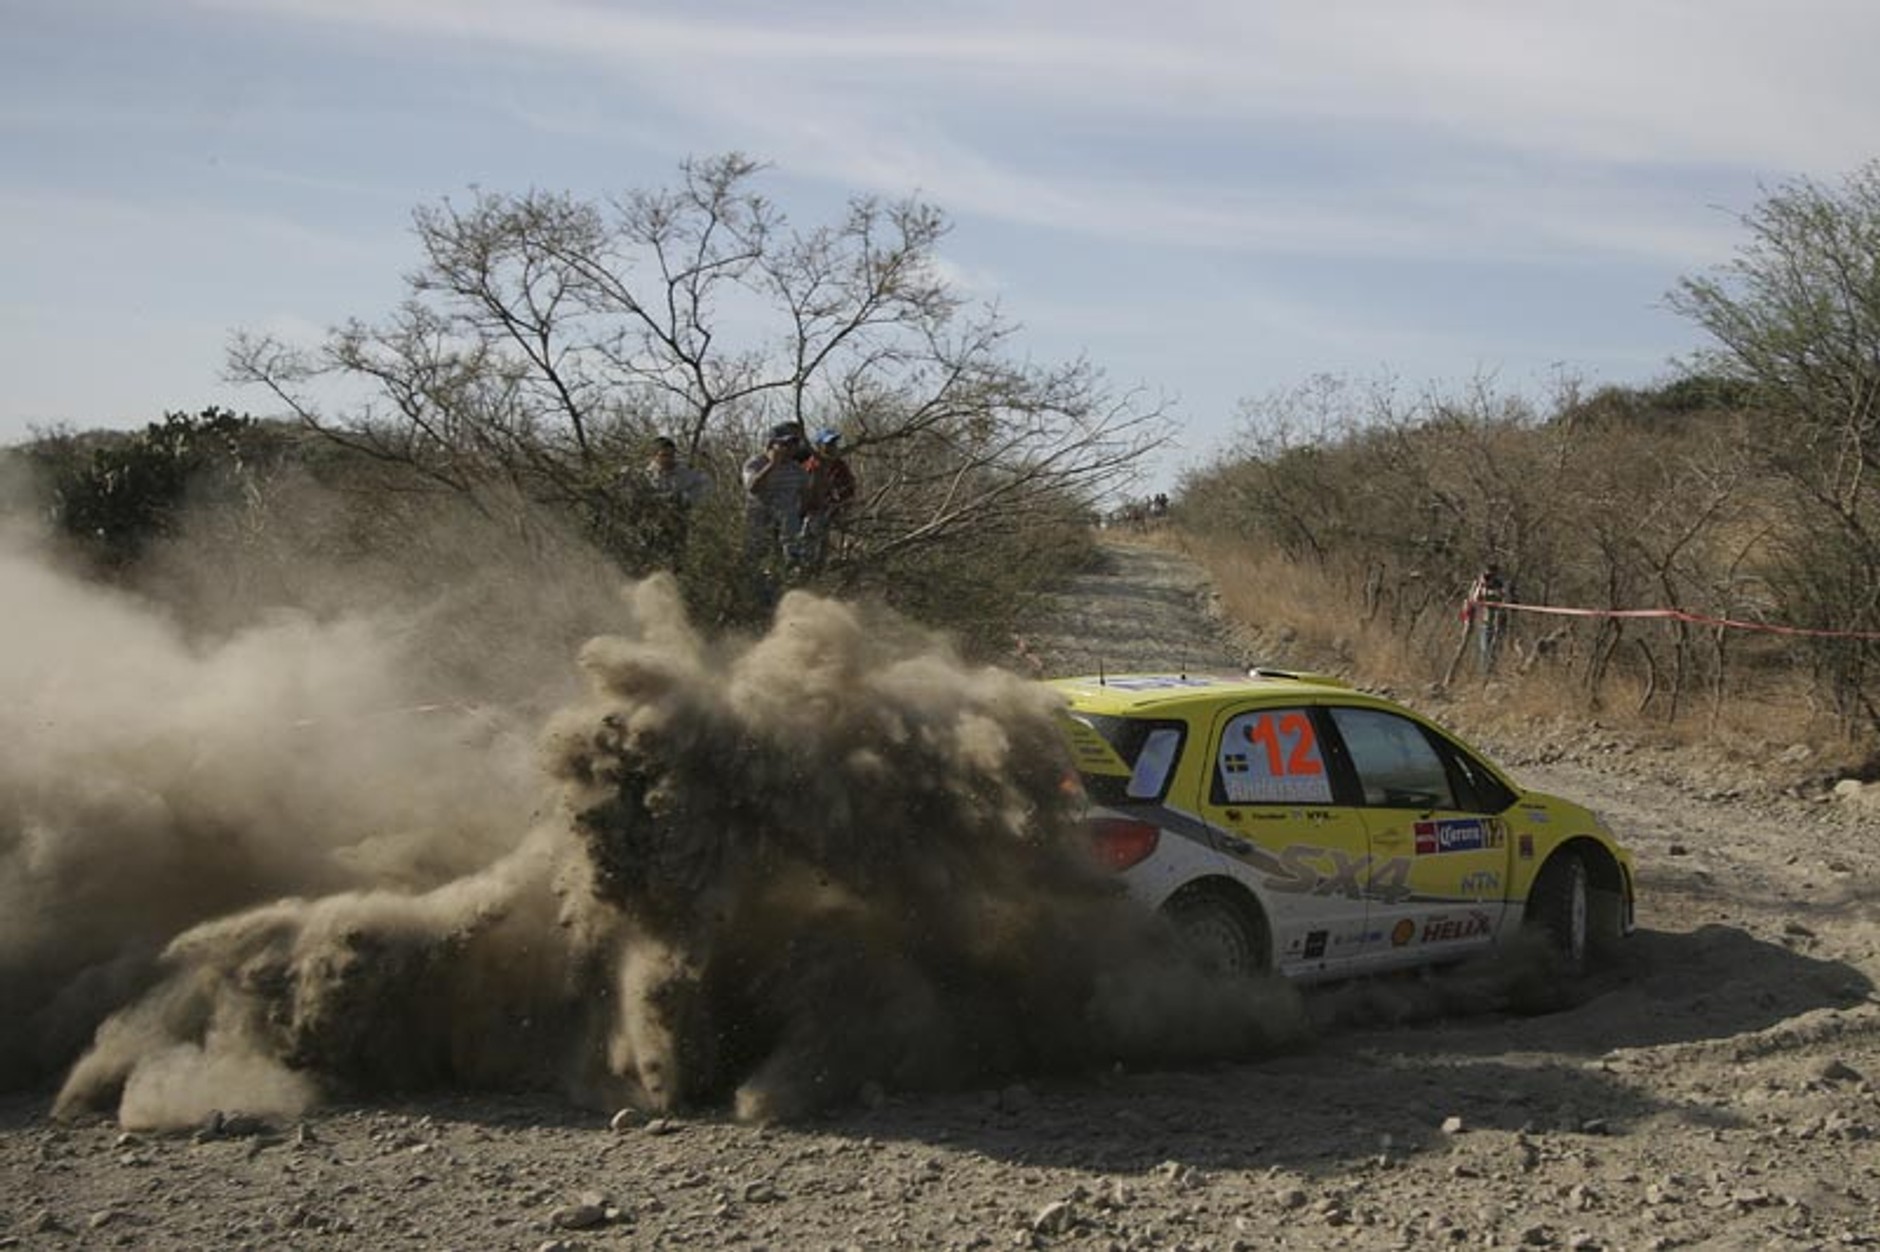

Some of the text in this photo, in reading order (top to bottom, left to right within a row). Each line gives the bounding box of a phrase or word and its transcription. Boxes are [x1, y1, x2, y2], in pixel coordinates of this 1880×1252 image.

[1252, 714, 1322, 776] 12
[1263, 845, 1413, 904] SX4
[1461, 870, 1500, 893] NTN
[1421, 912, 1490, 943] HELIX
